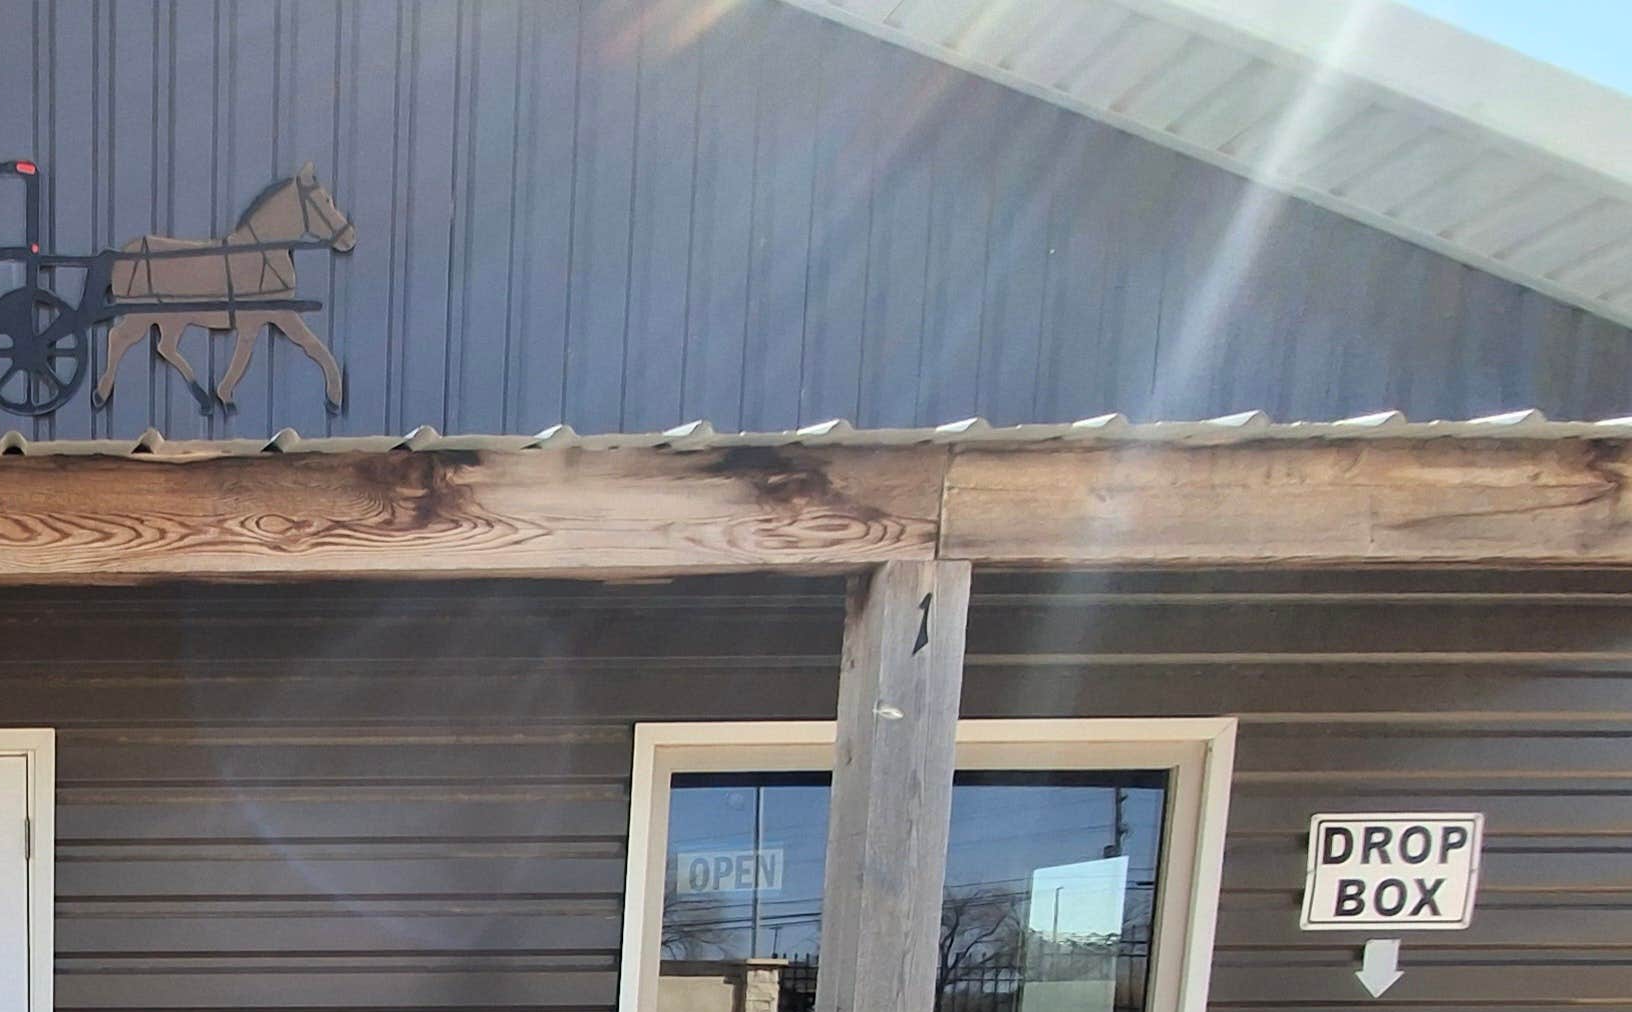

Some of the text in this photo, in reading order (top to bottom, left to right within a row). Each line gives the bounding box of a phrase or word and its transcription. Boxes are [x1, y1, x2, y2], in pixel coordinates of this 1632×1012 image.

[1321, 825, 1468, 865] DROP
[689, 854, 776, 891] OPEN
[1333, 878, 1447, 917] BOX
